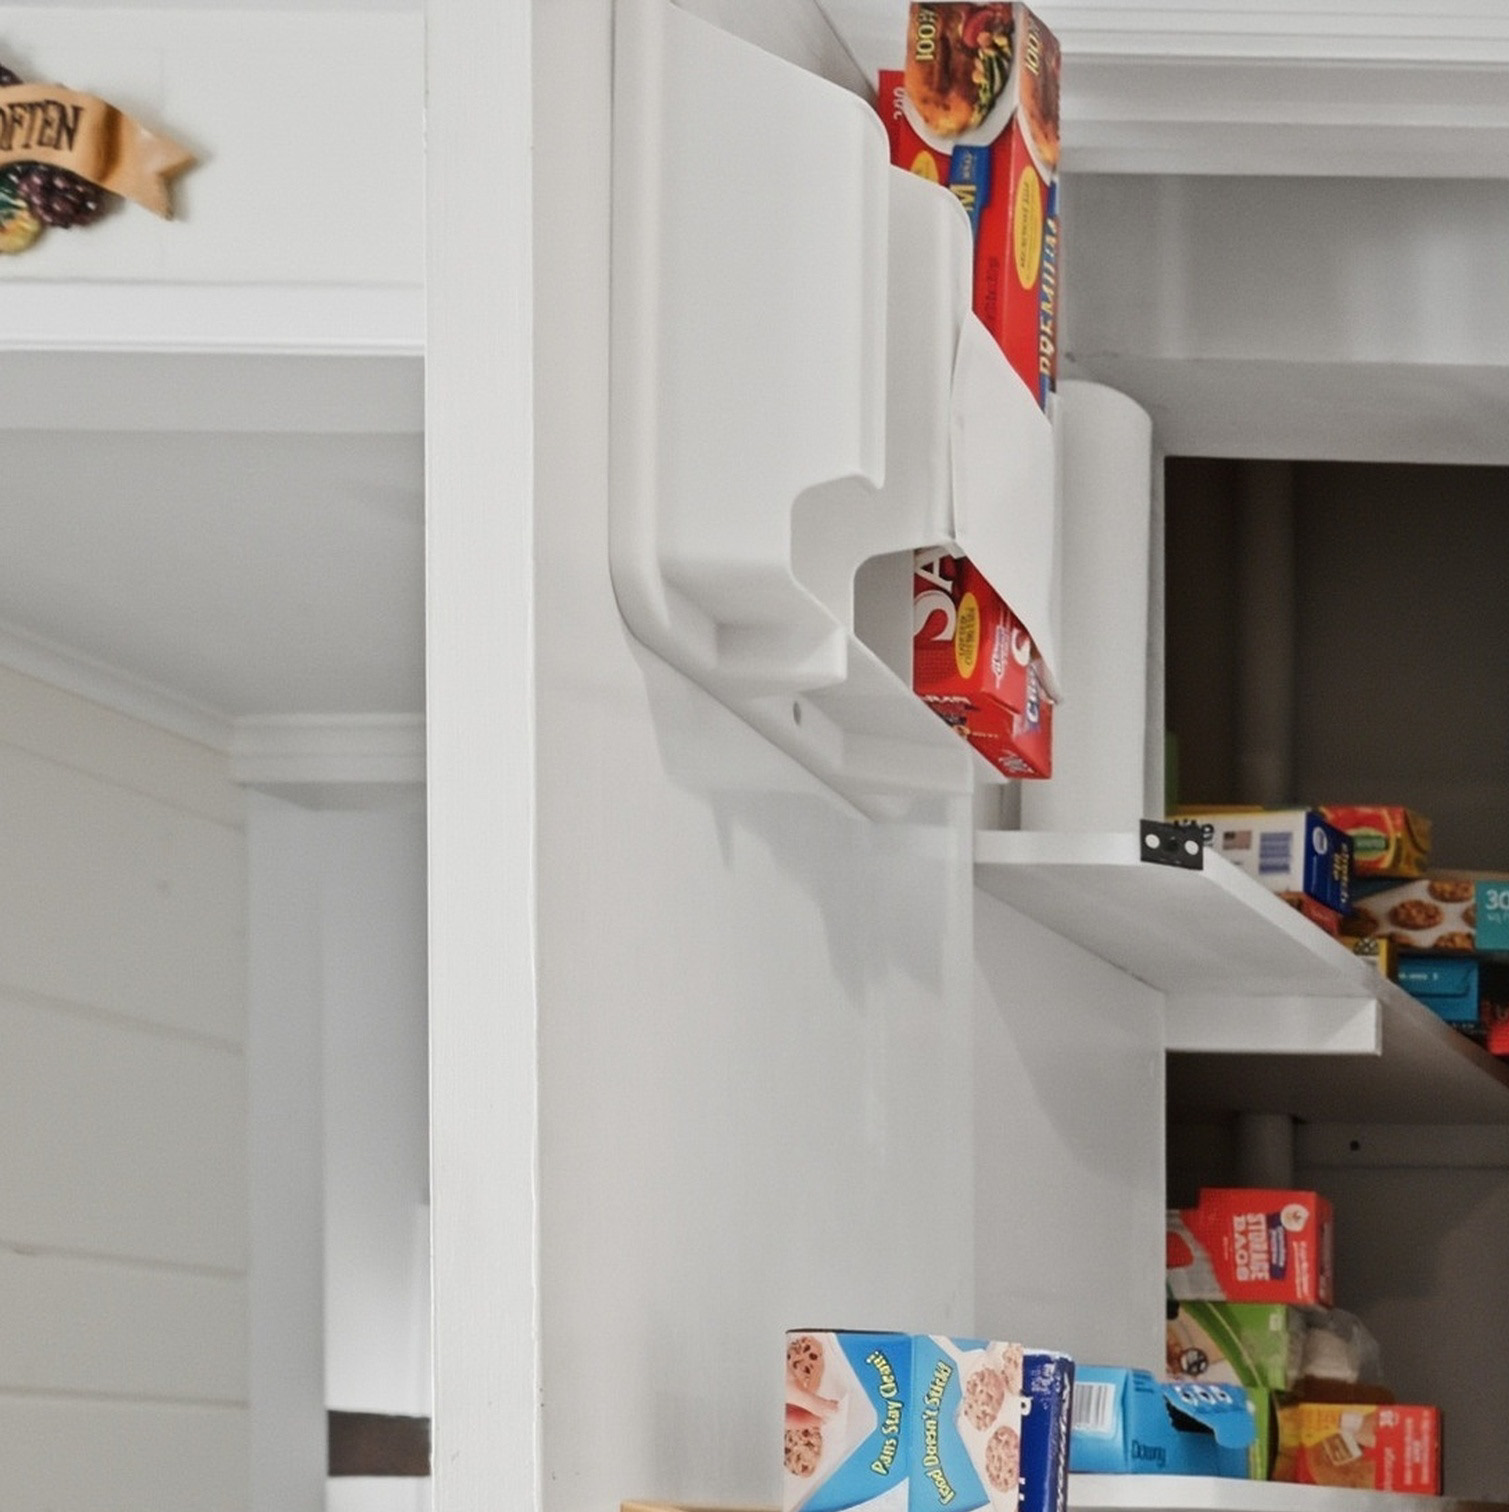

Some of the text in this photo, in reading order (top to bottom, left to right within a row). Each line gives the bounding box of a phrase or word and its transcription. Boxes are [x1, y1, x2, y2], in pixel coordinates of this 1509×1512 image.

[916, 23, 937, 62] 100
[1025, 32, 1041, 77] 100
[1232, 1214, 1250, 1282] BAGS
[866, 1351, 904, 1475] Pans Stay Clean!
[922, 1409, 940, 1468] Doesn't
[1132, 1440, 1167, 1468] Downy
